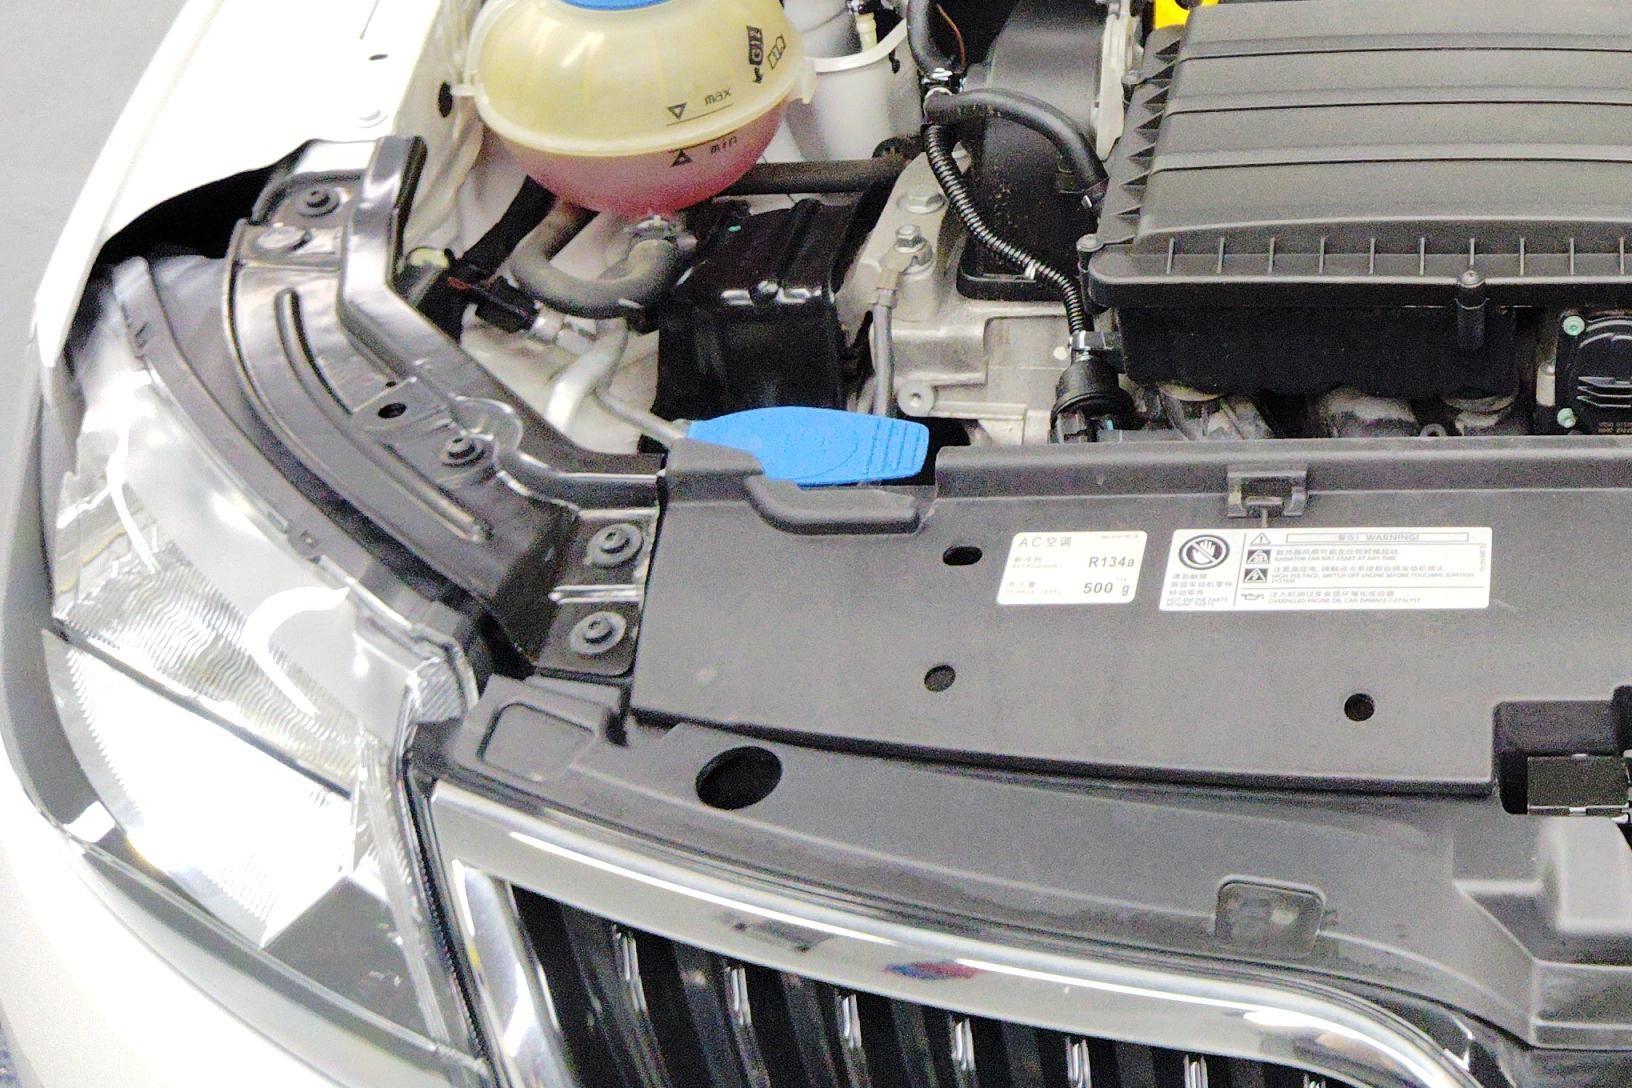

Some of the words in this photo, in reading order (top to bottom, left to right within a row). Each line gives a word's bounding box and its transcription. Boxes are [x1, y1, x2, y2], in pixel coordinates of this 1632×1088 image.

[704, 87, 732, 106] max
[710, 134, 738, 156] min
[1088, 556, 1134, 568] R134a
[1082, 582, 1113, 594] 500
[1122, 585, 1130, 596] g
